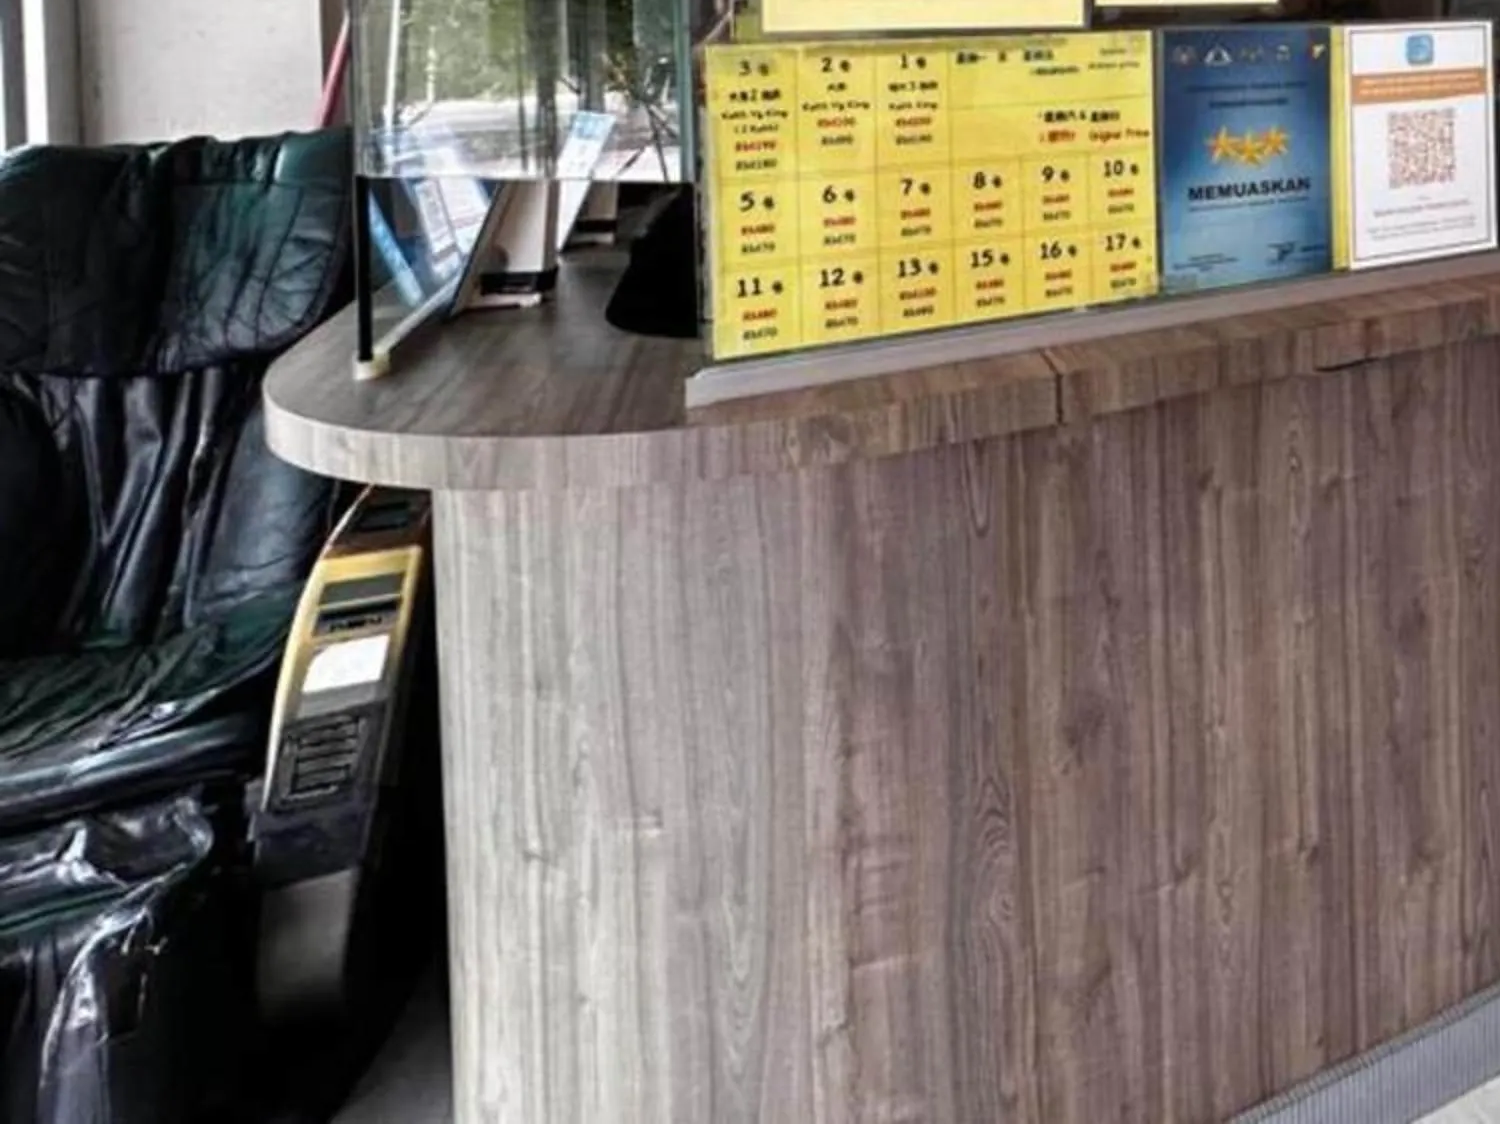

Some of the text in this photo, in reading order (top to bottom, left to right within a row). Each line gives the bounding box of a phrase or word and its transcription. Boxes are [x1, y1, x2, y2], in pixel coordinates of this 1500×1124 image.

[739, 61, 751, 76] 3
[821, 57, 833, 73] 2
[1042, 165, 1054, 184] 9
[1103, 160, 1124, 178] 10
[900, 179, 913, 196] 7
[973, 171, 986, 190] 8
[1186, 176, 1312, 202] MEMUASKAN
[740, 191, 755, 212] 5
[822, 184, 837, 204] 6
[1040, 241, 1063, 261] 16
[1104, 232, 1126, 252] 17
[897, 258, 922, 279] 13
[970, 249, 994, 270] 15
[736, 277, 762, 298] 11
[818, 267, 846, 288] 12
